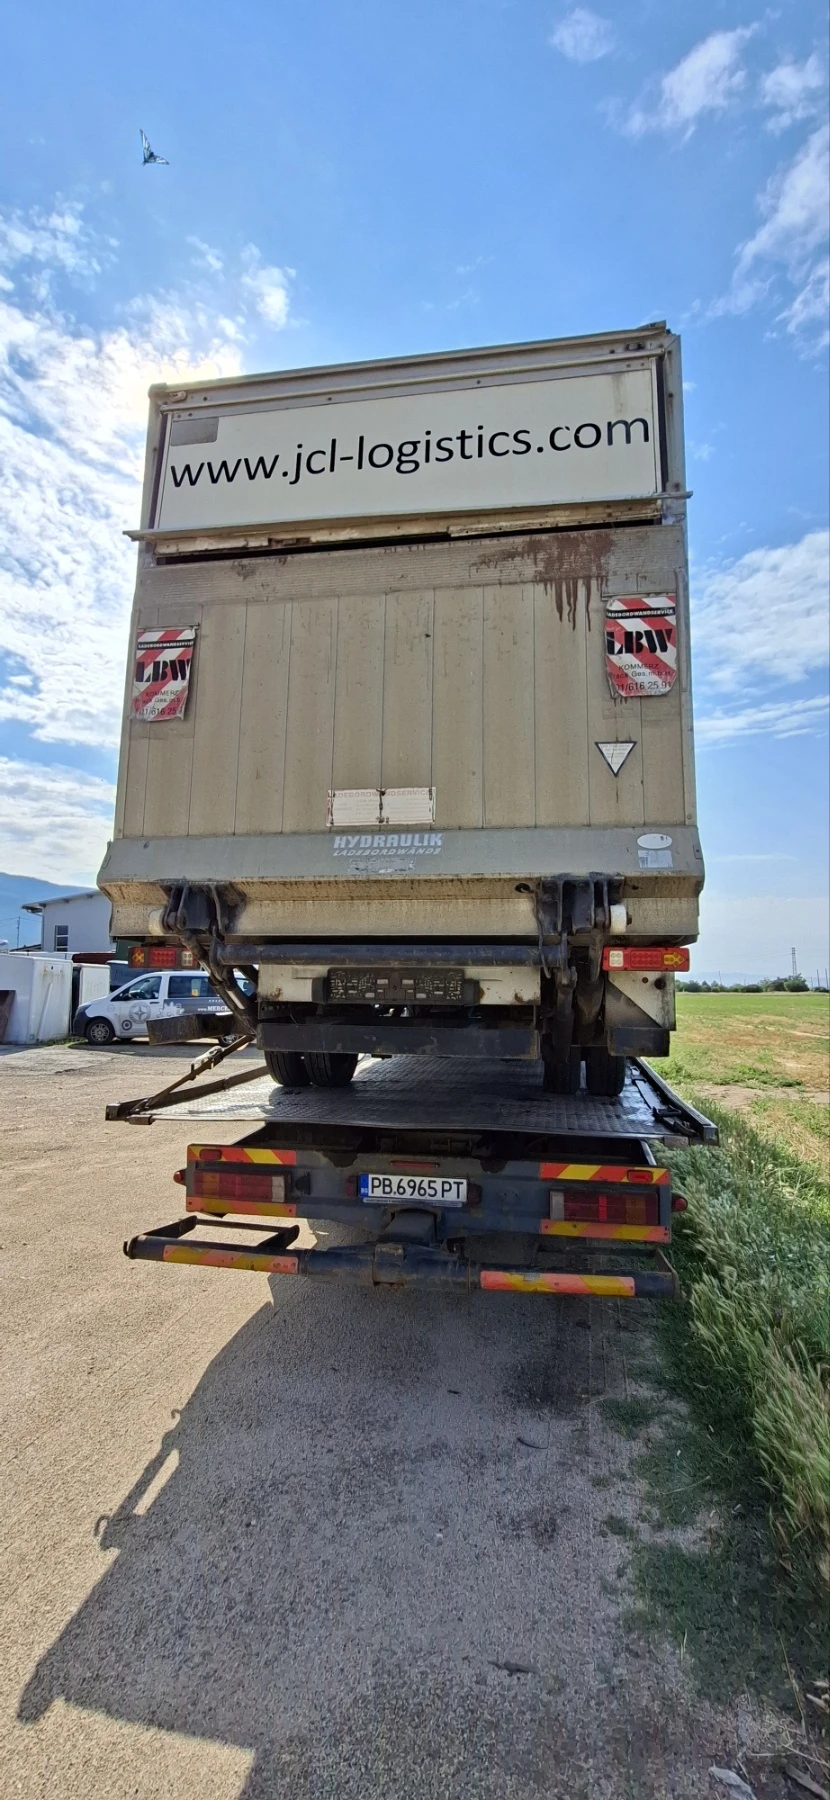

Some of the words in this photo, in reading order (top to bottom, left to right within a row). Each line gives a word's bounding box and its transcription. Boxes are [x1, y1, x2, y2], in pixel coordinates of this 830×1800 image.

[170, 416, 650, 489] www.jcl-logistics.com
[606, 629, 673, 654] LBW
[136, 659, 190, 682] LBW
[333, 833, 444, 849] HYDRAULIK
[333, 846, 442, 857] LADEBORDWÄNDE
